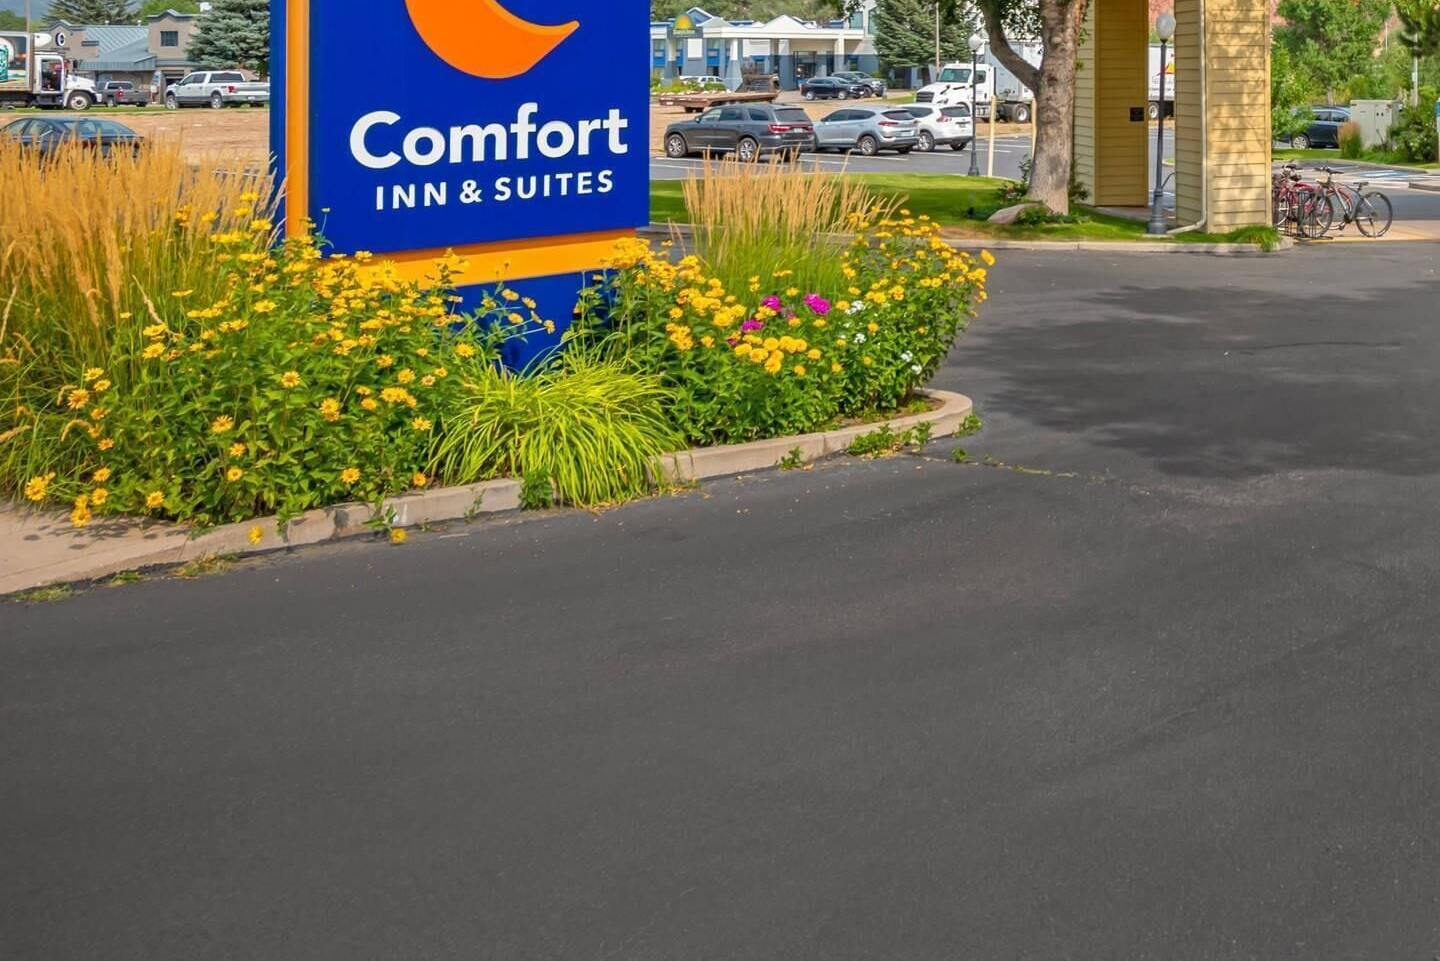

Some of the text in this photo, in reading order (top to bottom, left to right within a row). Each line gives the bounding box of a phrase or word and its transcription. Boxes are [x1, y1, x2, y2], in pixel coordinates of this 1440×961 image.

[349, 102, 628, 169] Comfort
[376, 169, 613, 210] INN & SUITES
